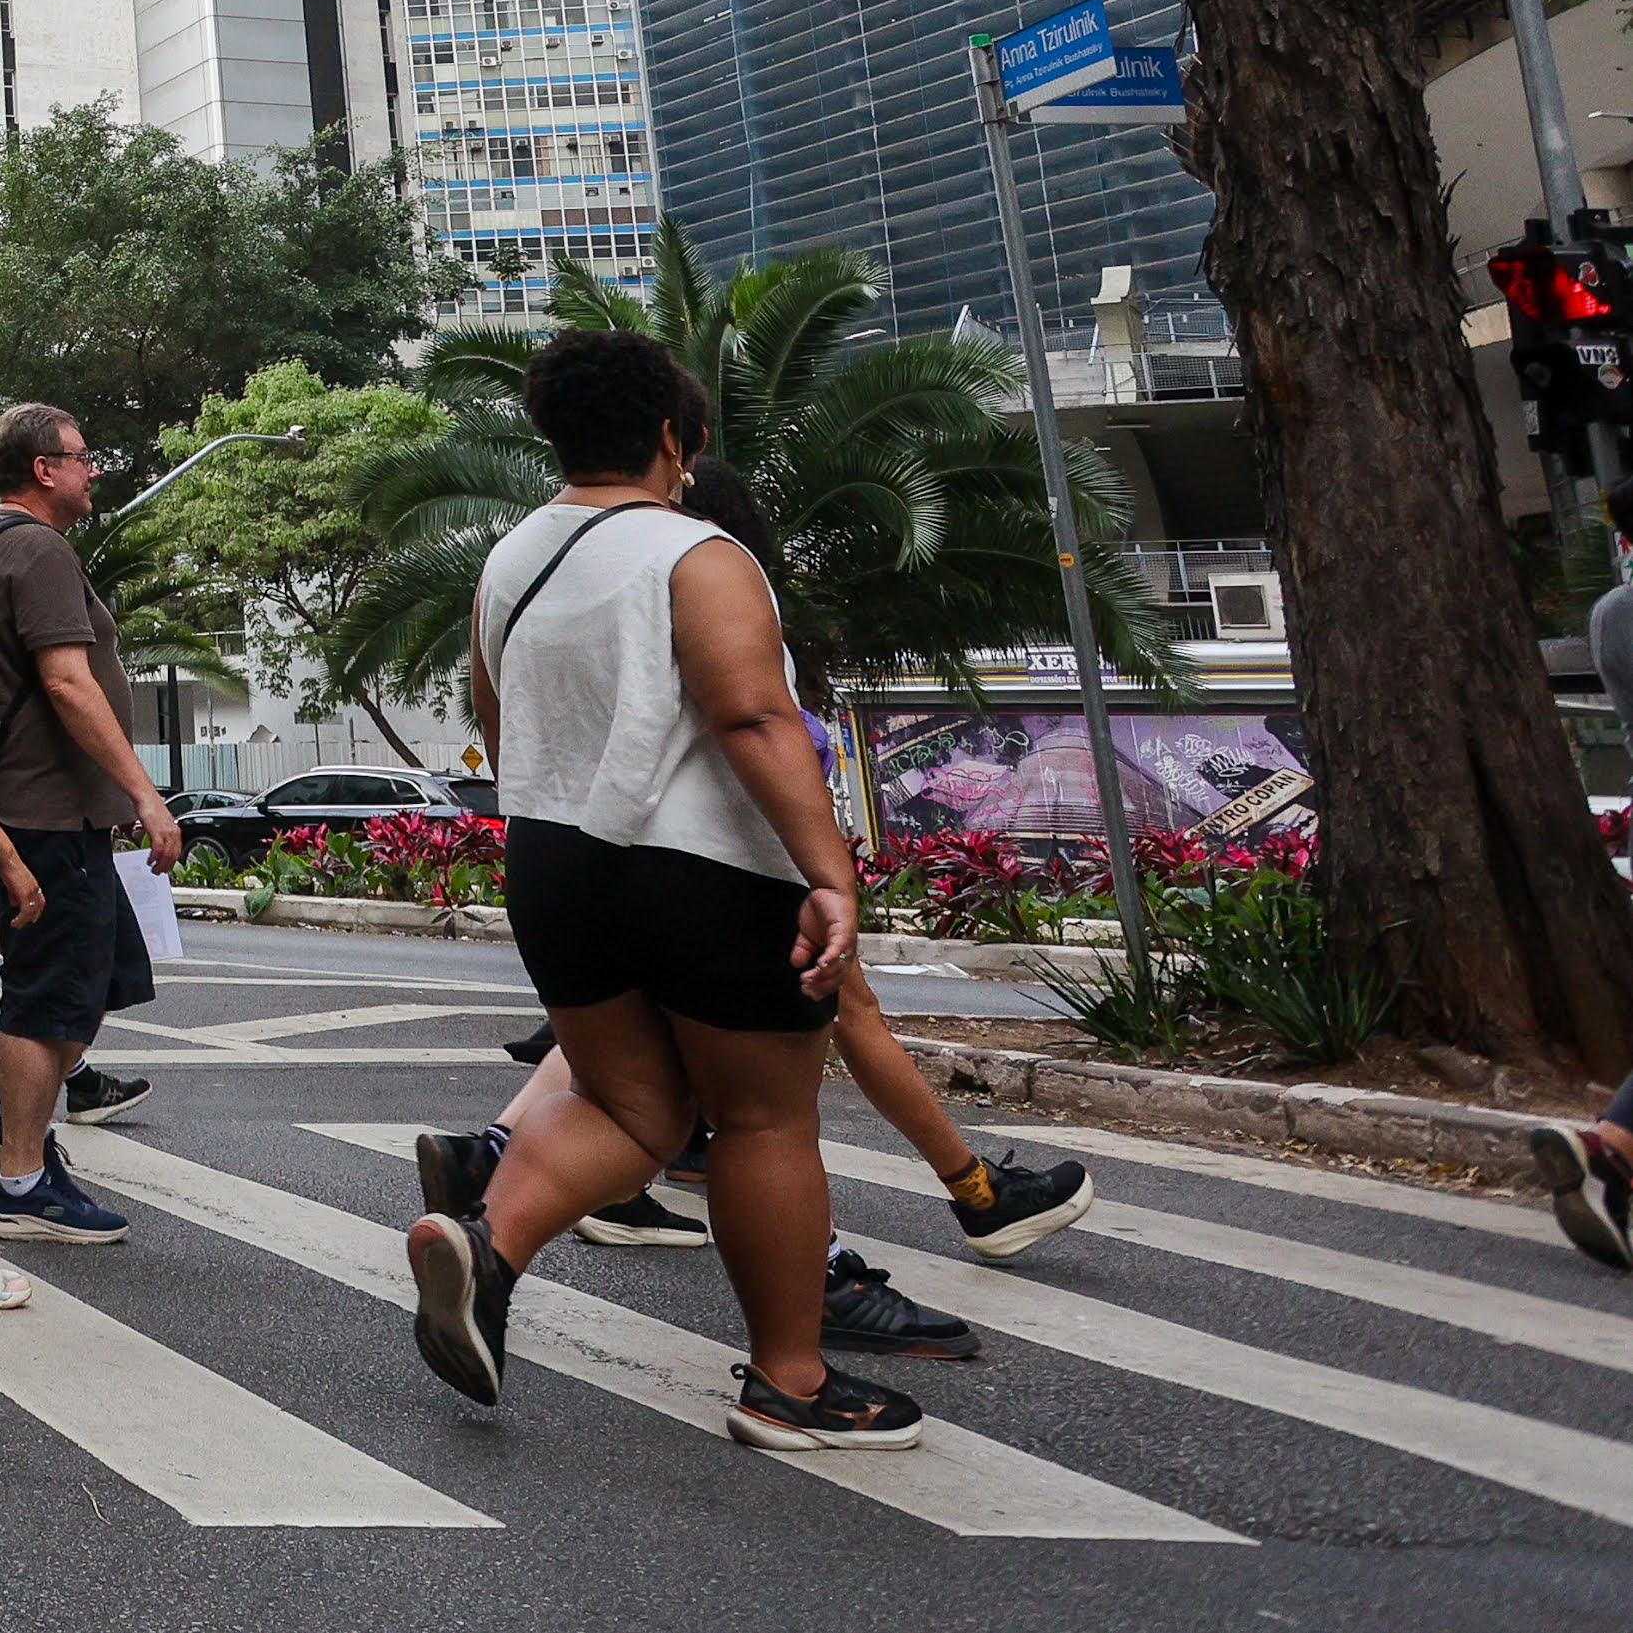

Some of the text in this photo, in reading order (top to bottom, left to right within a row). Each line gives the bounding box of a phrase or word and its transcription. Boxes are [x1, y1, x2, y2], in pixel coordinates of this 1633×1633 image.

[1000, 9, 1100, 72] Anna Tzirulnik
[1115, 55, 1165, 79] ulnik
[1246, 773, 1297, 806] COPAN
